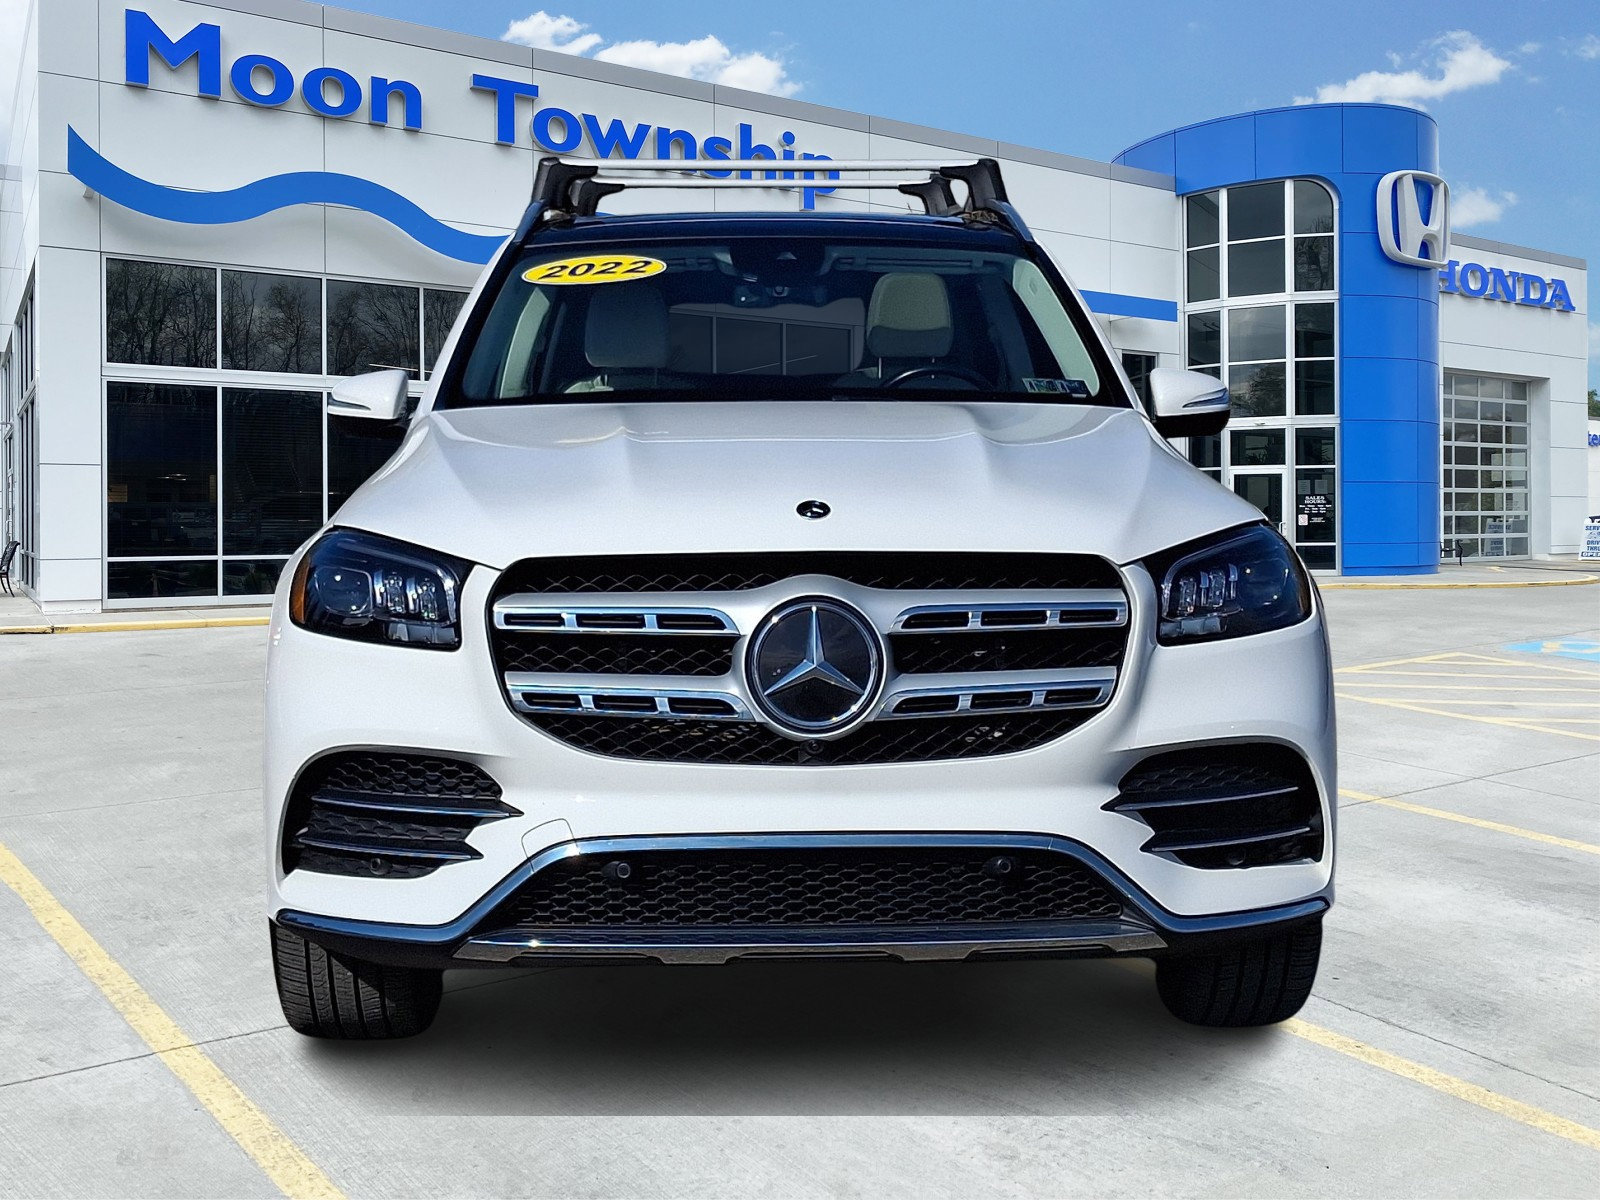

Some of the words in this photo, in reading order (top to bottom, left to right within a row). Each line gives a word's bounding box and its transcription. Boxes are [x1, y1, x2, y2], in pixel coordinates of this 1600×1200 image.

[125, 9, 422, 131] Moon
[469, 73, 840, 211] Township
[538, 260, 652, 280] 2022
